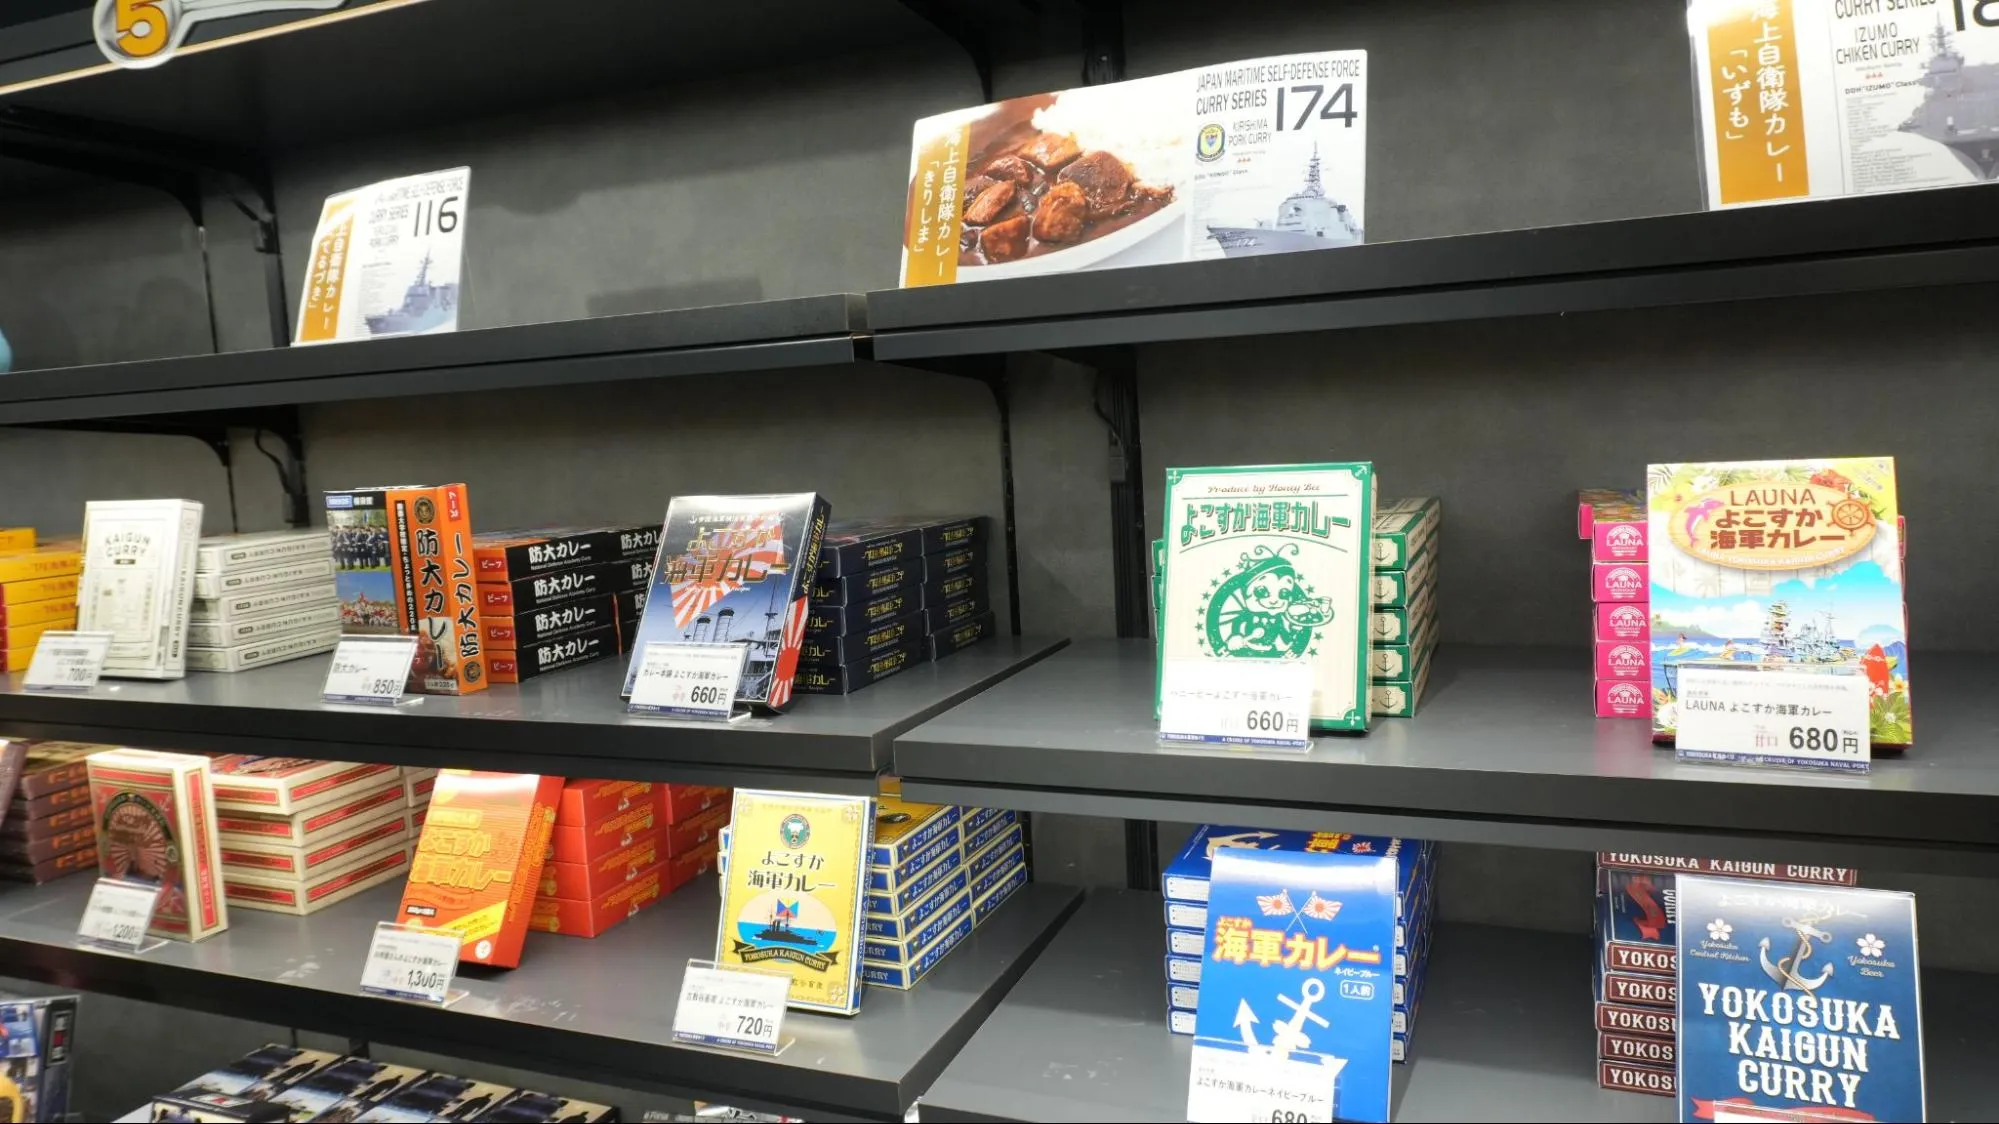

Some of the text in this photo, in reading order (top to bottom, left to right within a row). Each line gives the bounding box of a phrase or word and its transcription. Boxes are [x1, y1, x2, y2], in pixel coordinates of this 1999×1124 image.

[1855, 22, 1898, 43] IZUMO
[1836, 37, 1920, 64] CHIKEN CURRY
[1197, 59, 1360, 93] JAPAN MARITIME SELF-DEFENSE FORCE
[1196, 89, 1267, 115] CURRY SERIES
[1276, 83, 1358, 132] 174
[414, 196, 459, 237] 116
[1268, 483, 1301, 494] Honey
[1303, 483, 1321, 491] Bee
[1730, 488, 1816, 506] LAUNA
[1181, 501, 1351, 547] よこすか海軍カレー
[1715, 508, 1823, 528] よこすか
[621, 530, 660, 549] 防大カレ
[1606, 539, 1644, 547] LAUNA
[1710, 529, 1845, 549] 海軍カレー
[528, 540, 592, 563] 防大カレー
[481, 559, 503, 569] ビーフ
[451, 532, 480, 657] 防大カレー
[534, 572, 595, 597] 防大カレー
[1605, 581, 1643, 589] LAUNA
[415, 528, 446, 669] 防大カレー
[487, 593, 508, 602] ビーフ
[535, 607, 596, 632] 防大カレー
[1609, 620, 1647, 628] LAUNA
[490, 629, 511, 638] ビーフ
[537, 638, 599, 665] 防大カレー
[1608, 658, 1645, 666] LAUNA
[493, 662, 513, 670] ビーフ
[691, 685, 728, 705] 660円
[1607, 697, 1644, 705] LAUNA
[1686, 700, 1832, 717] LAUNA よこすか海軍カレー
[1247, 710, 1298, 733] 660円
[1789, 726, 1858, 754] 680円
[761, 851, 824, 870] よこすか
[1610, 852, 1848, 882] YOKOSUKA KAIGUN CURRY
[748, 870, 835, 892] 海軍カレー
[1213, 928, 1381, 969] 海軍カレー
[804, 956, 826, 970] CURRY
[1617, 949, 1676, 970] YOKOS
[1343, 982, 1372, 997] 1人前
[1616, 980, 1676, 1001] YOKOS
[1607, 1010, 1676, 1032] YOKOS
[1698, 982, 1900, 1040] YOKOSUKA
[737, 1015, 773, 1037] 720円
[1610, 1040, 1674, 1060] YOKOS
[1728, 1020, 1869, 1073] KAIGUN
[1610, 1068, 1676, 1090] YOKOS
[1737, 1059, 1861, 1108] CURRY
